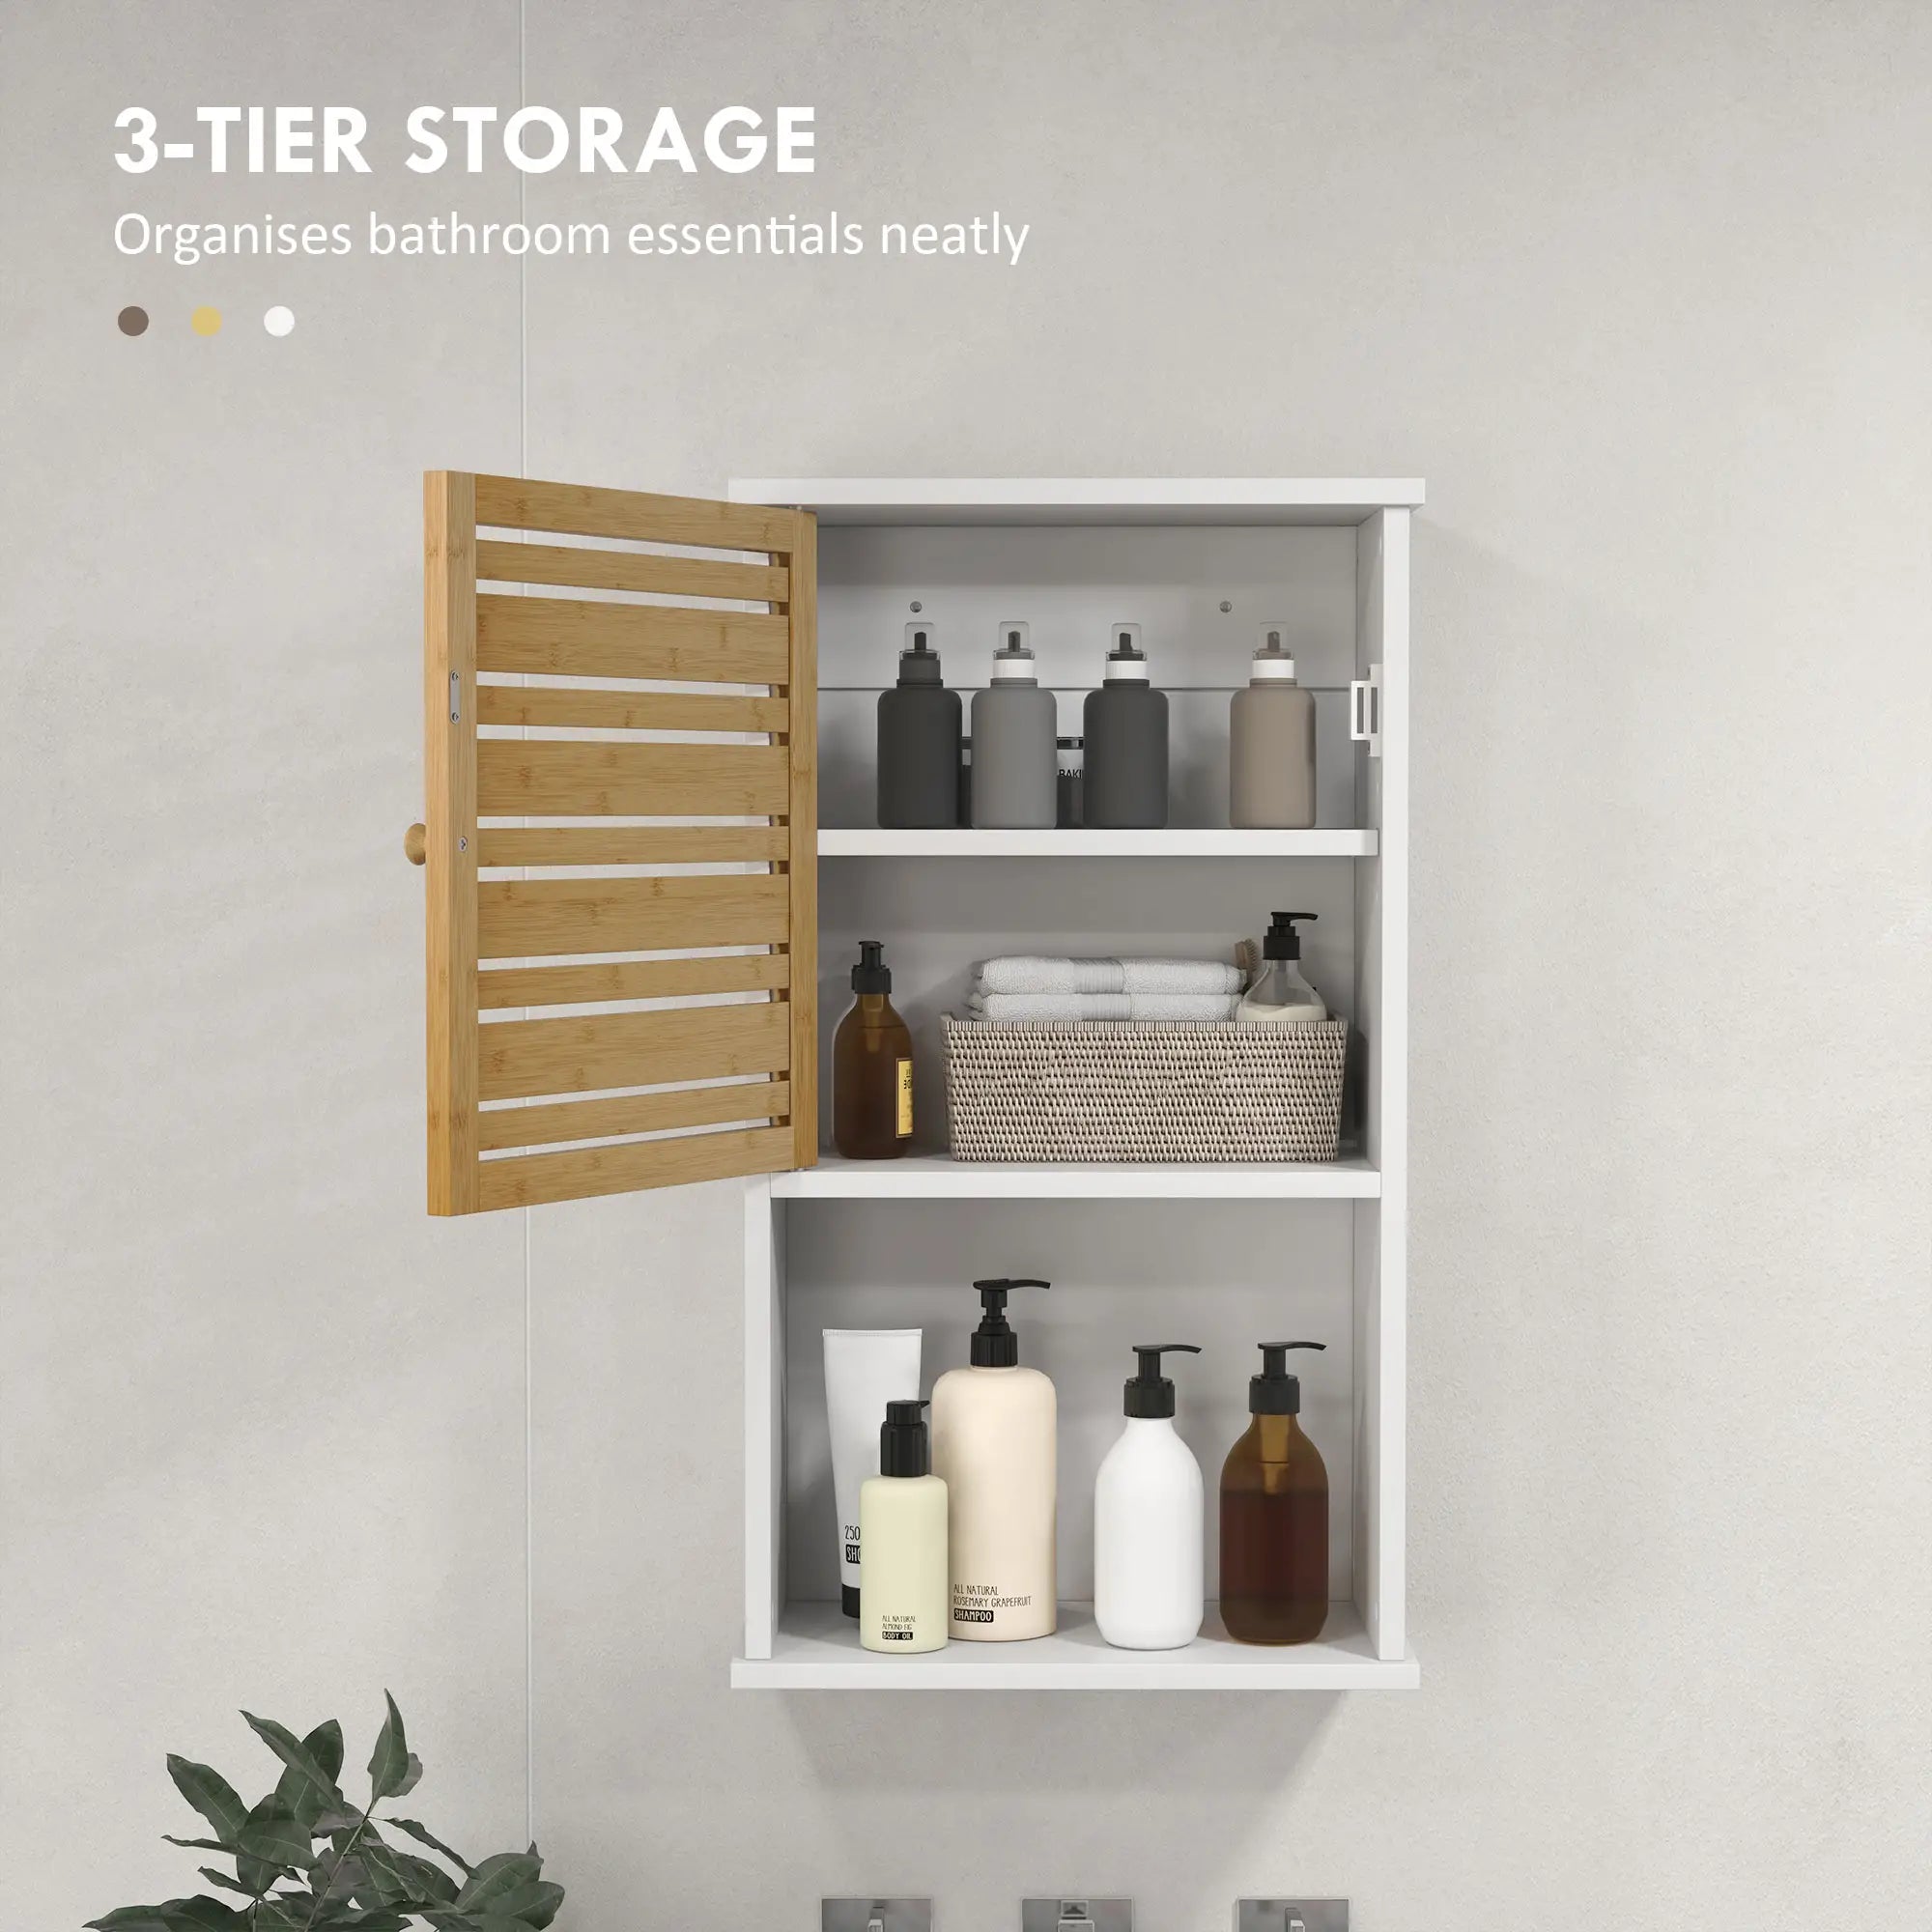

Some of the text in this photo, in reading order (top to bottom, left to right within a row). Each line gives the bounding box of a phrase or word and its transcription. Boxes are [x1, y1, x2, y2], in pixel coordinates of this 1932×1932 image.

[845, 1524, 860, 1541] 250
[953, 1583, 999, 1596] ALL NATURAL
[953, 1595, 1032, 1607] ROSEMARY GRAPEFRUIT
[954, 1608, 992, 1622] SHAMPOO
